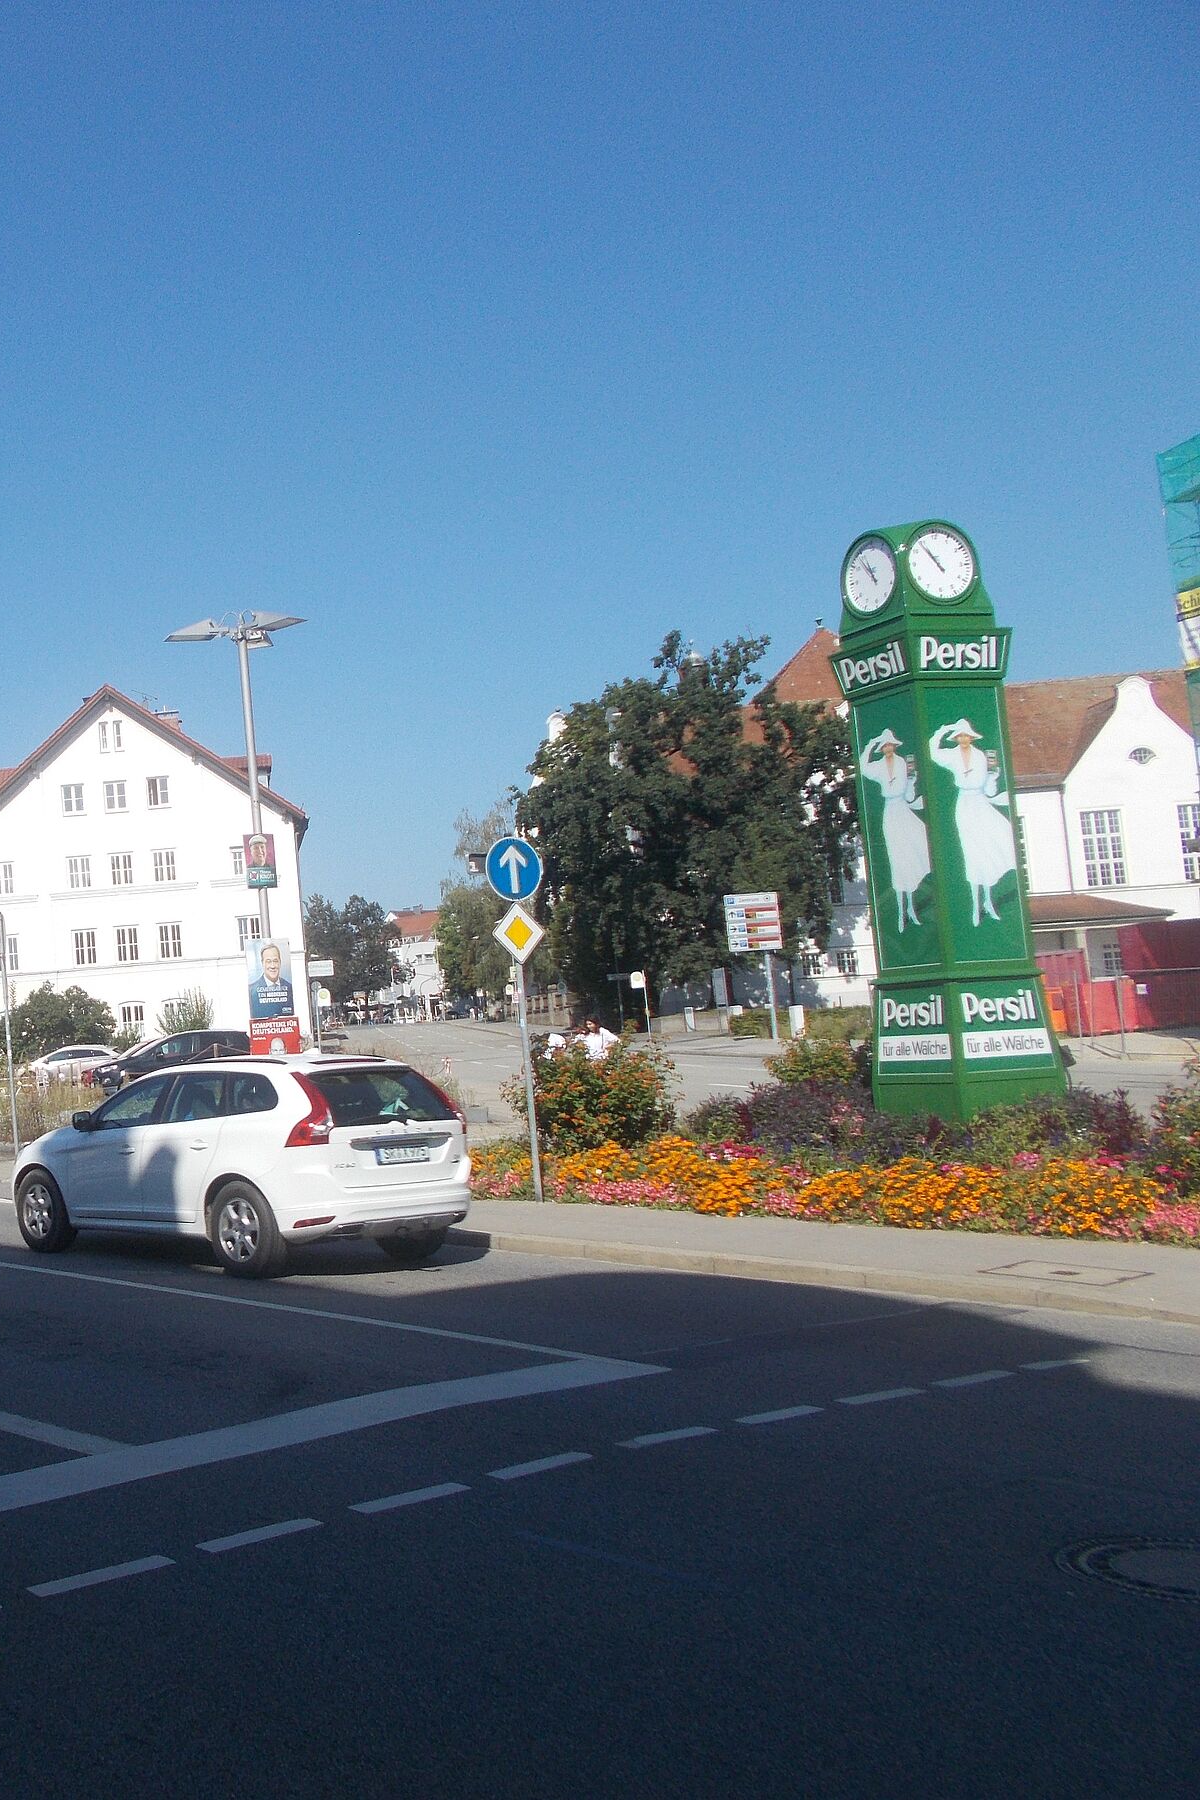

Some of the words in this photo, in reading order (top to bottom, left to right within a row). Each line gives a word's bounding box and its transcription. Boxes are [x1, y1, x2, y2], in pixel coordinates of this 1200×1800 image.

[840, 640, 906, 688] Persil
[920, 635, 999, 669] Persil
[882, 994, 943, 1027] Persil
[961, 989, 1036, 1023] Persil
[882, 1041, 894, 1056] für
[895, 1041, 911, 1056] alle
[966, 1037, 981, 1053] für
[983, 1036, 1002, 1052] alle
